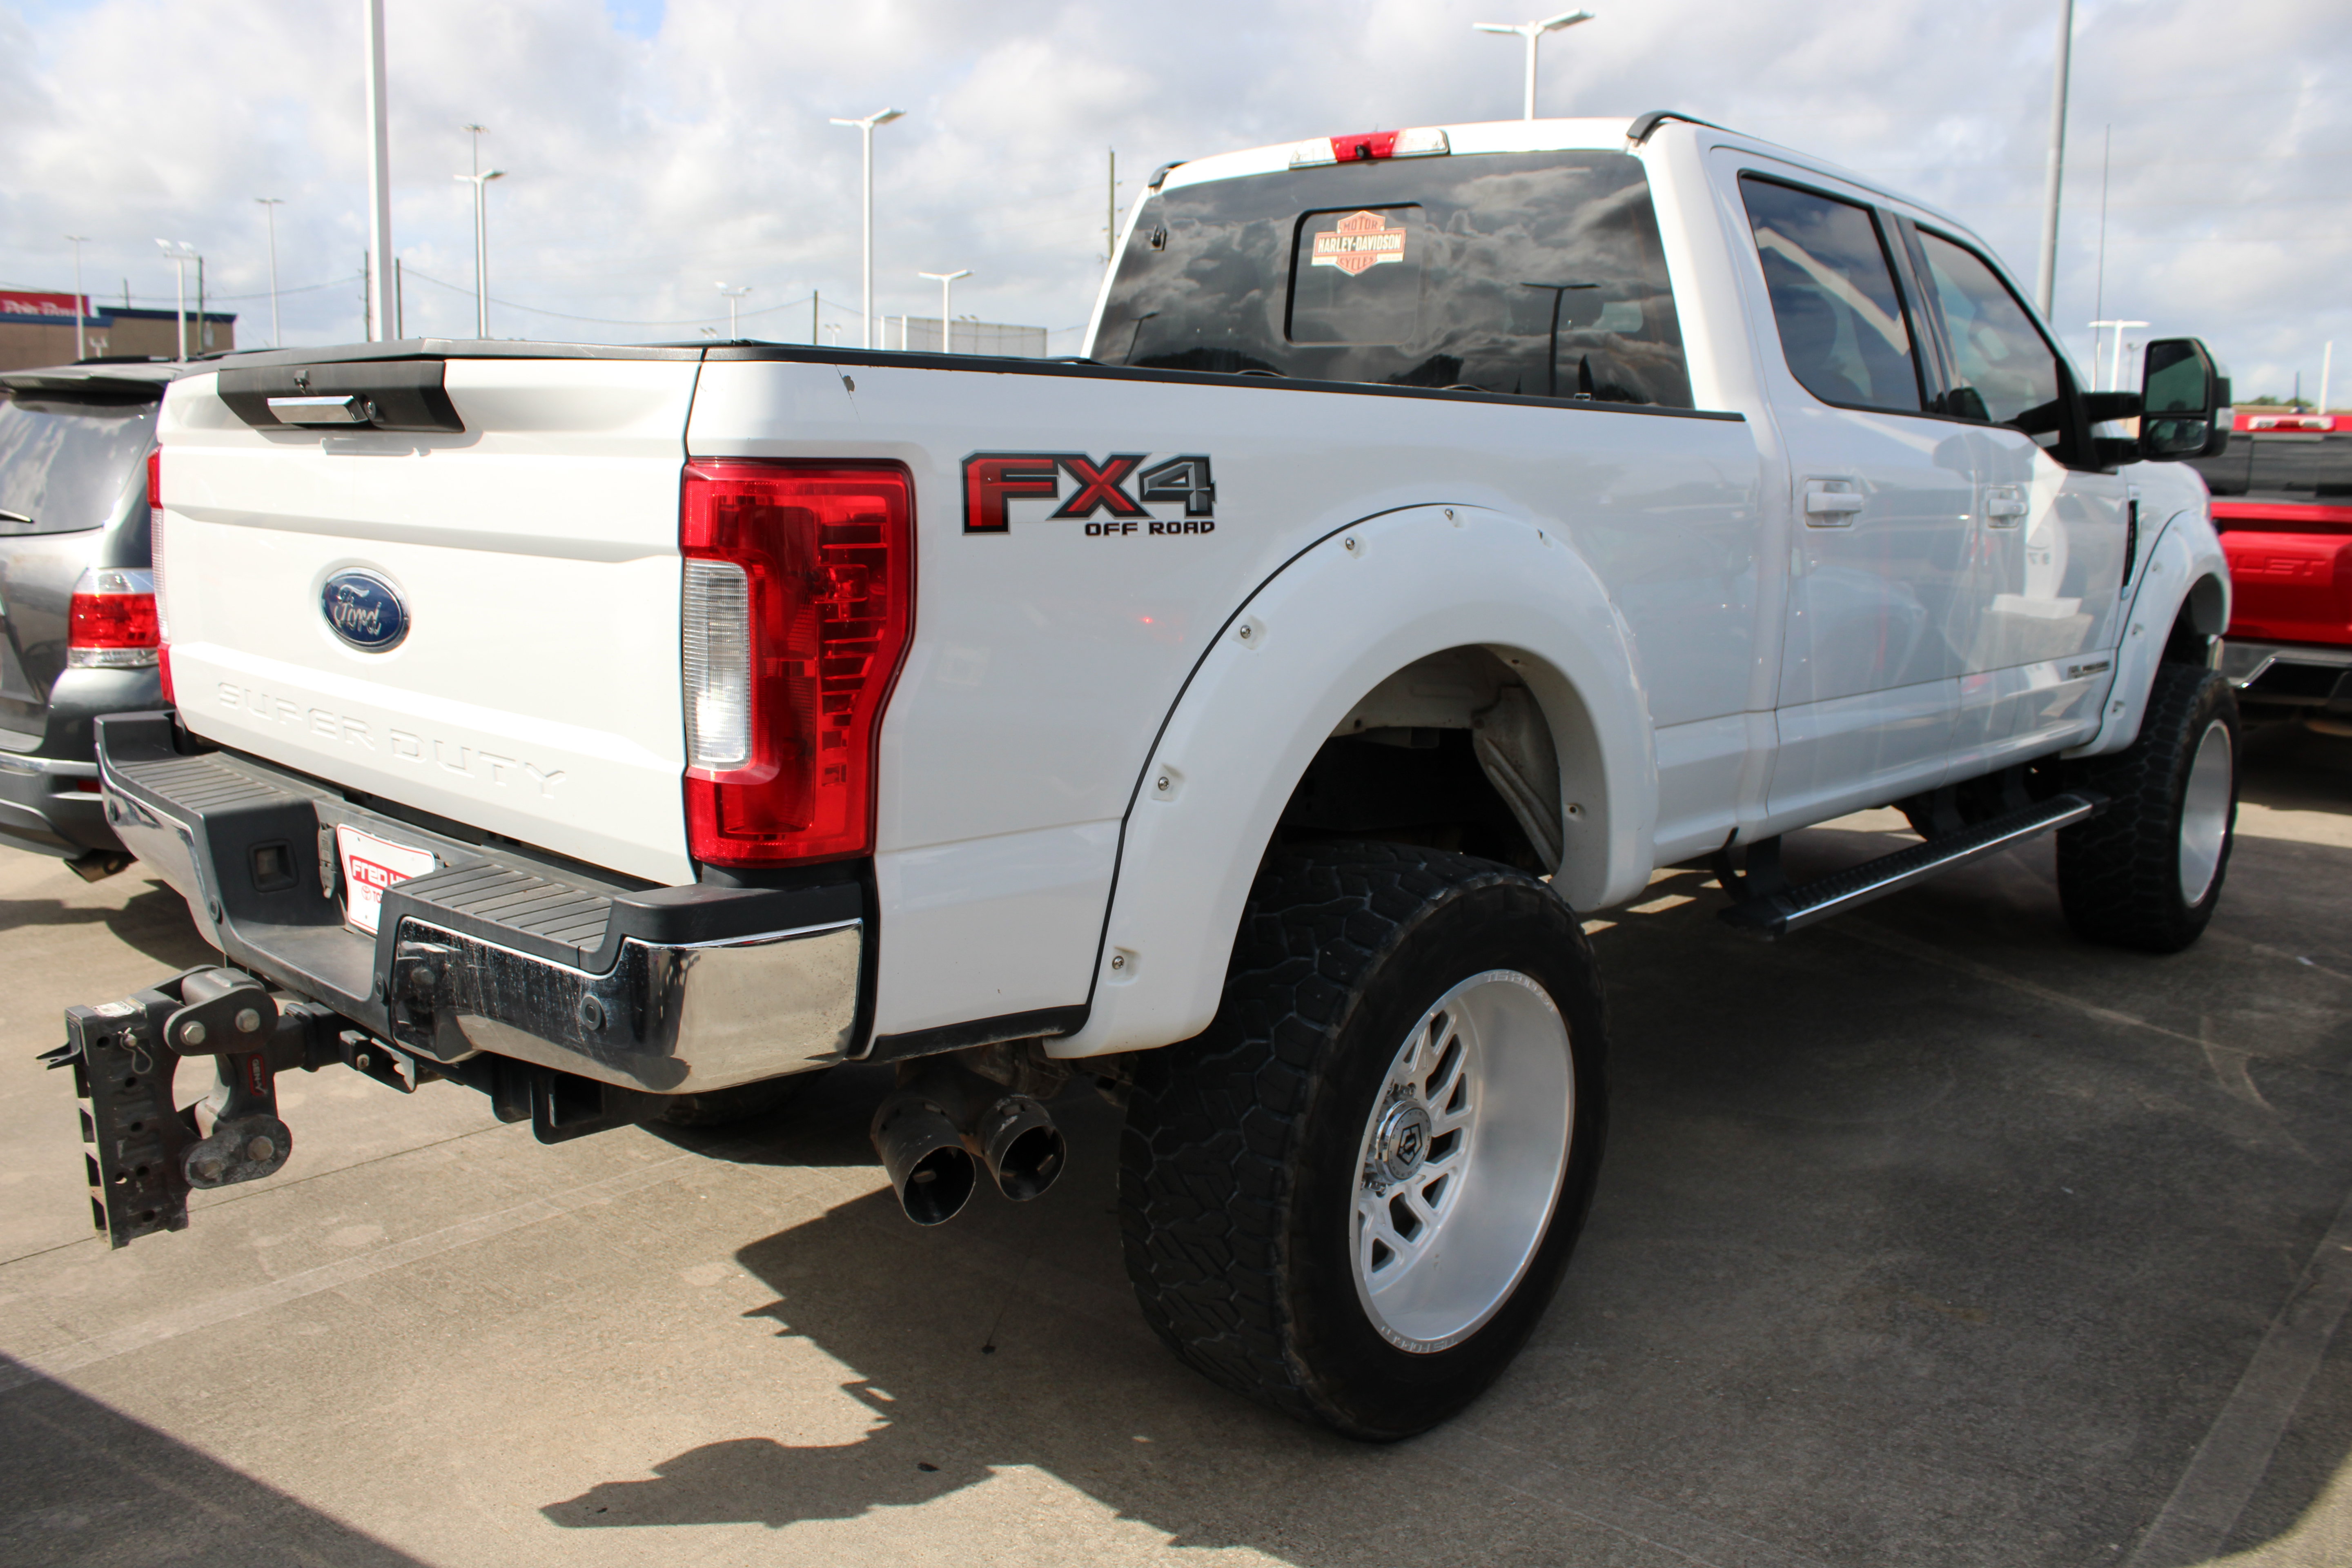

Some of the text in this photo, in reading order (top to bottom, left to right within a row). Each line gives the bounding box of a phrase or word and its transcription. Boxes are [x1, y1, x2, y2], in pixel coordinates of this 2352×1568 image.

[1343, 216, 1378, 231] MOTOR
[1340, 257, 1373, 271] CYCLES
[959, 450, 1217, 536] FX4
[1085, 521, 1215, 536] OFF ROAD
[334, 584, 382, 636] Ford
[218, 682, 566, 799] SUPER DUTY
